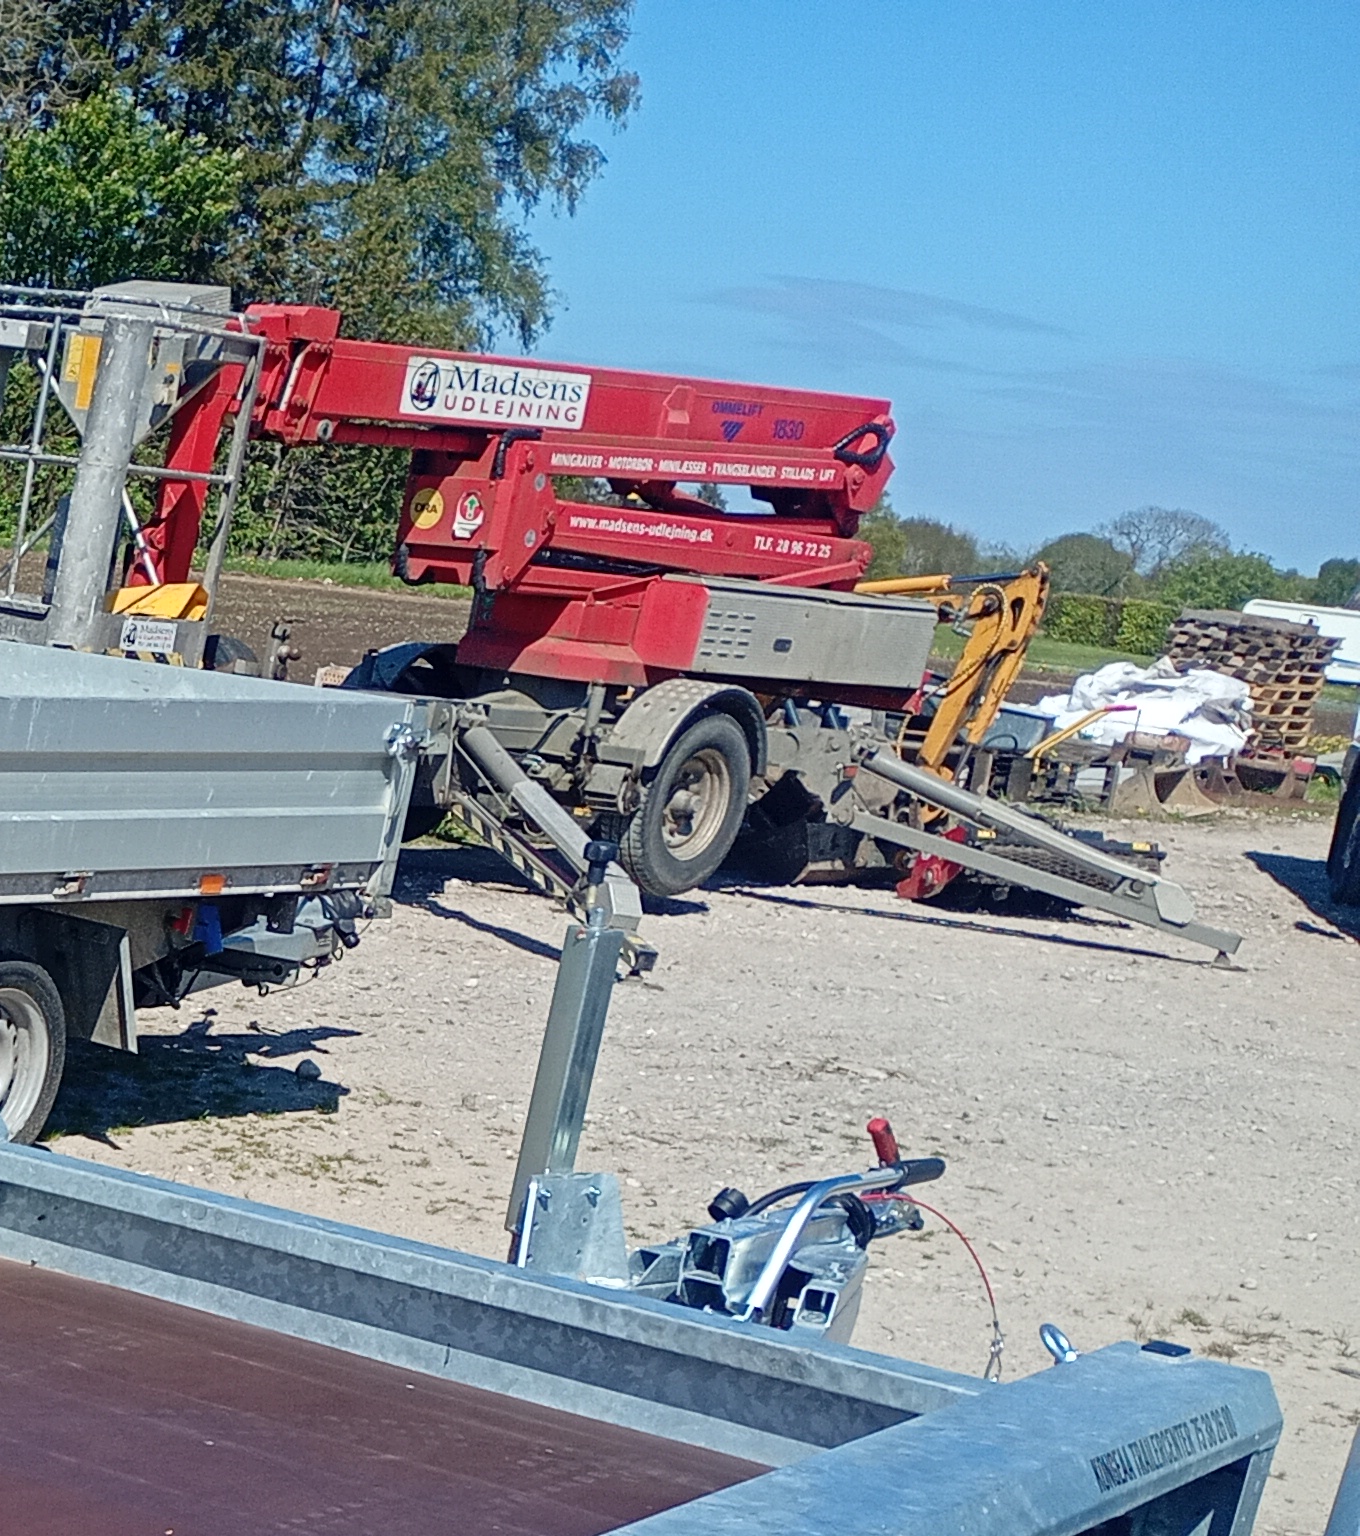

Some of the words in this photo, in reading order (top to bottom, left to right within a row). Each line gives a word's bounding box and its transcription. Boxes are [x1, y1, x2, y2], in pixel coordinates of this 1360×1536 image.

[446, 365, 584, 403] Madsens
[444, 395, 578, 423] UDLEJNING
[711, 401, 765, 418] OMMELIFT
[551, 452, 604, 469] MINIGRAVER
[819, 468, 836, 482] LIFT
[569, 515, 713, 544] www.madsens-udlejning.dk
[775, 538, 790, 554] 28
[790, 540, 805, 555] 96
[804, 542, 818, 557] 72
[818, 543, 832, 558] 25
